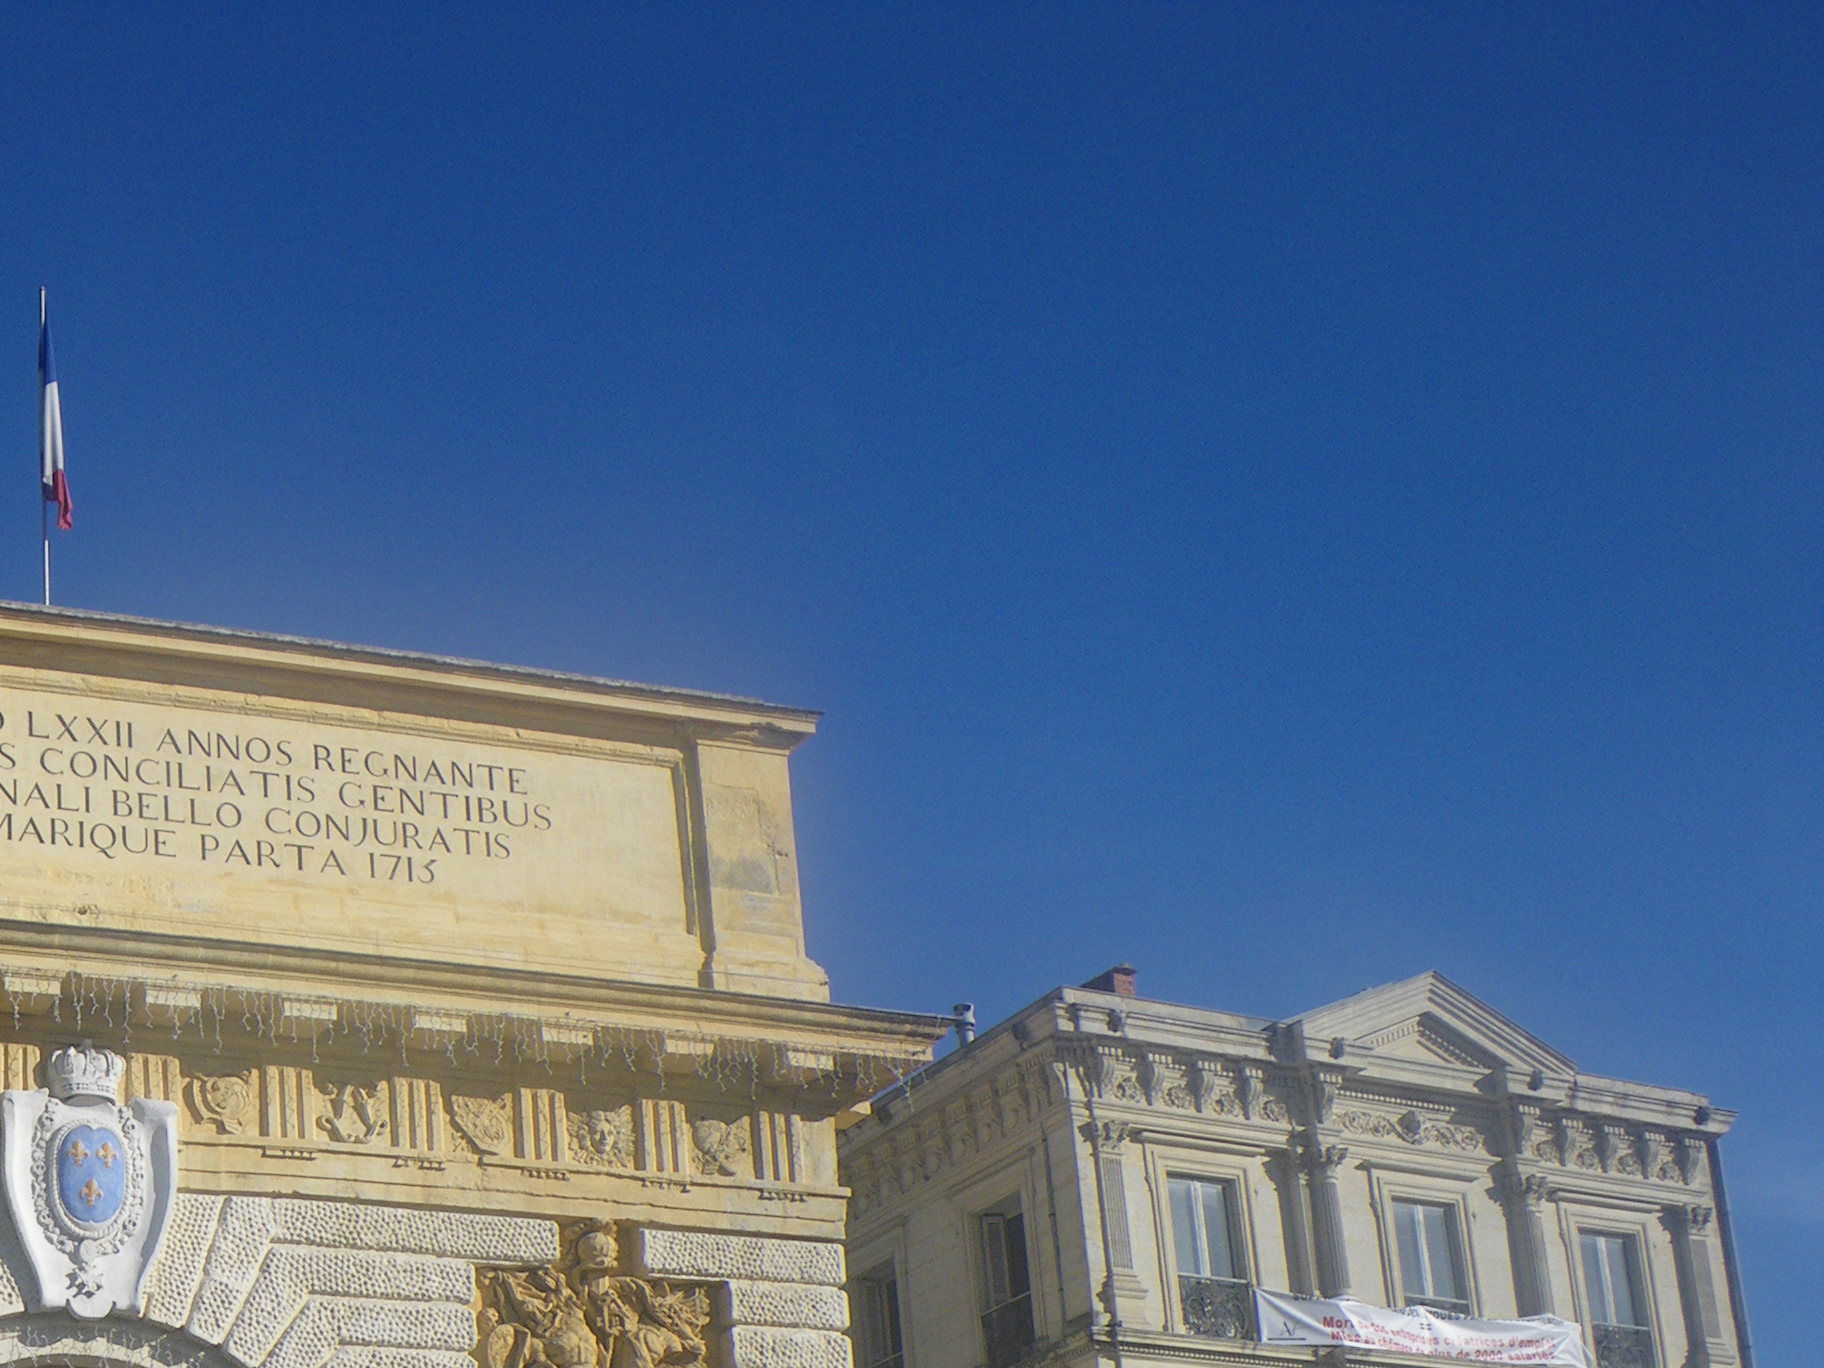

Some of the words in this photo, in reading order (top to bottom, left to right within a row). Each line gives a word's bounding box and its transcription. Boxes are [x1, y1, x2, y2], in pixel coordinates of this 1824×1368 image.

[28, 711, 132, 748] LXXII
[157, 728, 292, 765] ANNOS
[313, 744, 527, 795] REGNANTE
[40, 748, 315, 802] CONCILIATIS
[339, 782, 551, 829] GENTIBUS
[112, 790, 241, 828] BELLO
[265, 808, 510, 859] CONJURATIS
[201, 834, 346, 875] PARTA
[369, 853, 437, 883] 1715
